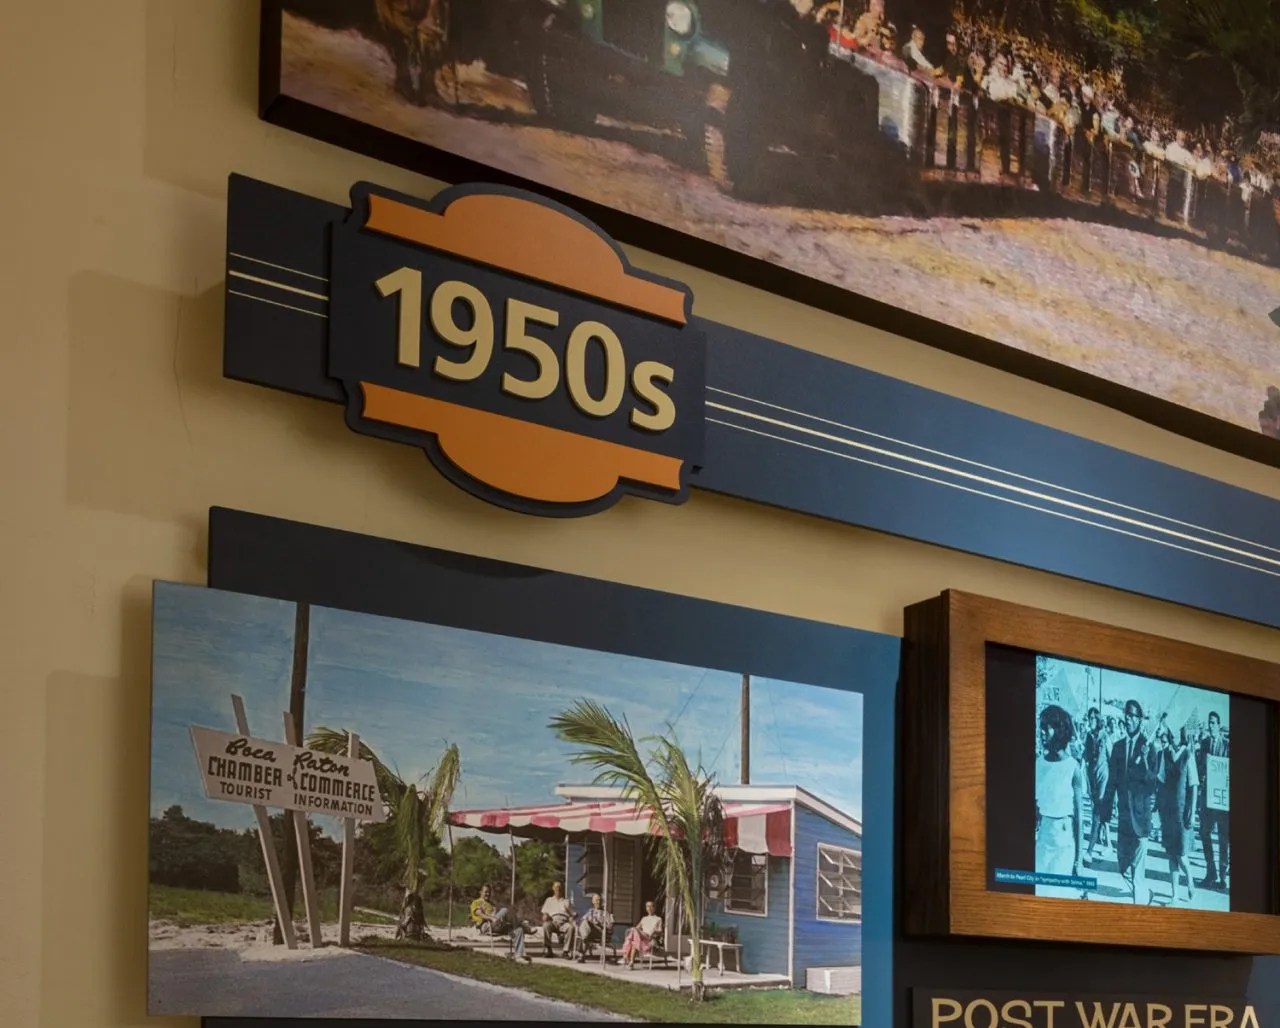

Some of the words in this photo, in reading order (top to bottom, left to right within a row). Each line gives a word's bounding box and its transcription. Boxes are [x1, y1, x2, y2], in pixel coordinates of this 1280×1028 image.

[375, 268, 677, 430] 1950s
[208, 756, 282, 786] CHAMBER
[300, 773, 374, 802] COMMERCE
[226, 739, 276, 762] Boca
[293, 752, 349, 777] Raton
[220, 782, 272, 800] TOURIST
[294, 794, 372, 815] INFORMATION
